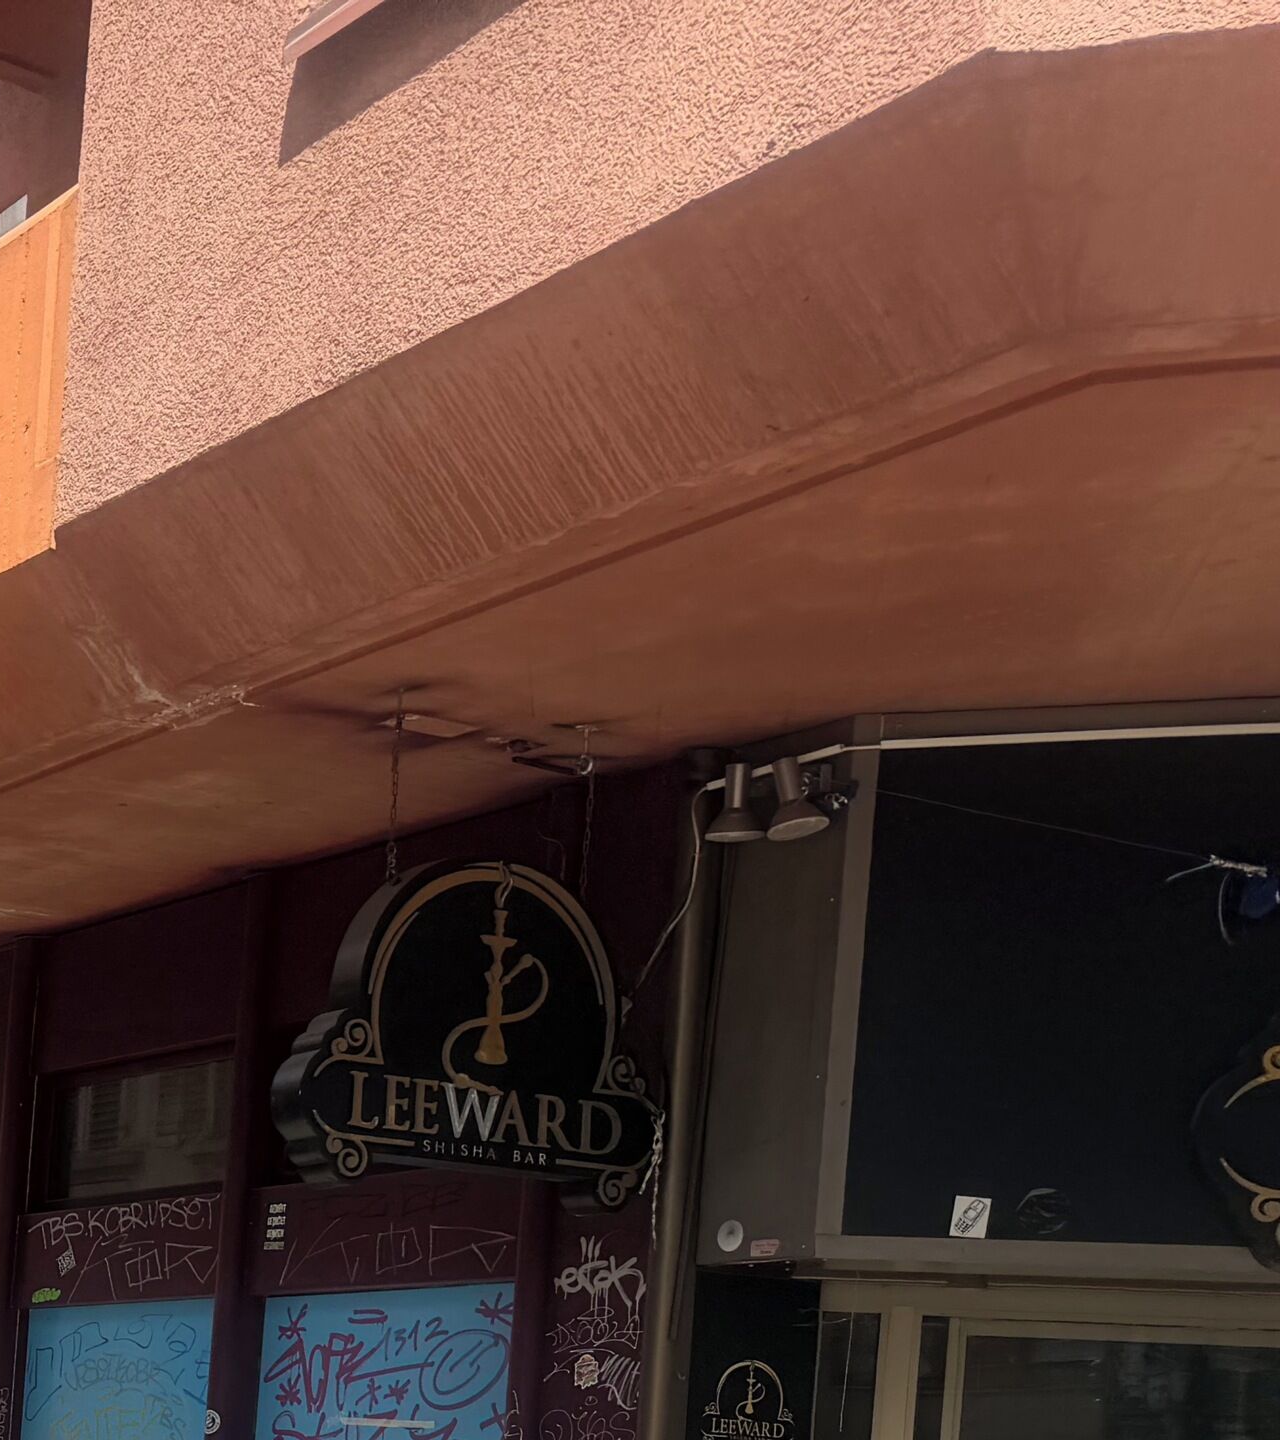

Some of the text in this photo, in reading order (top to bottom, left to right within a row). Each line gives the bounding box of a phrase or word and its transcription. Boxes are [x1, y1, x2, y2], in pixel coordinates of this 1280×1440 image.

[347, 1071, 622, 1155] LEEWARD
[423, 1140, 547, 1166] SHISHA BAR
[712, 1418, 785, 1438] LEEWARD
